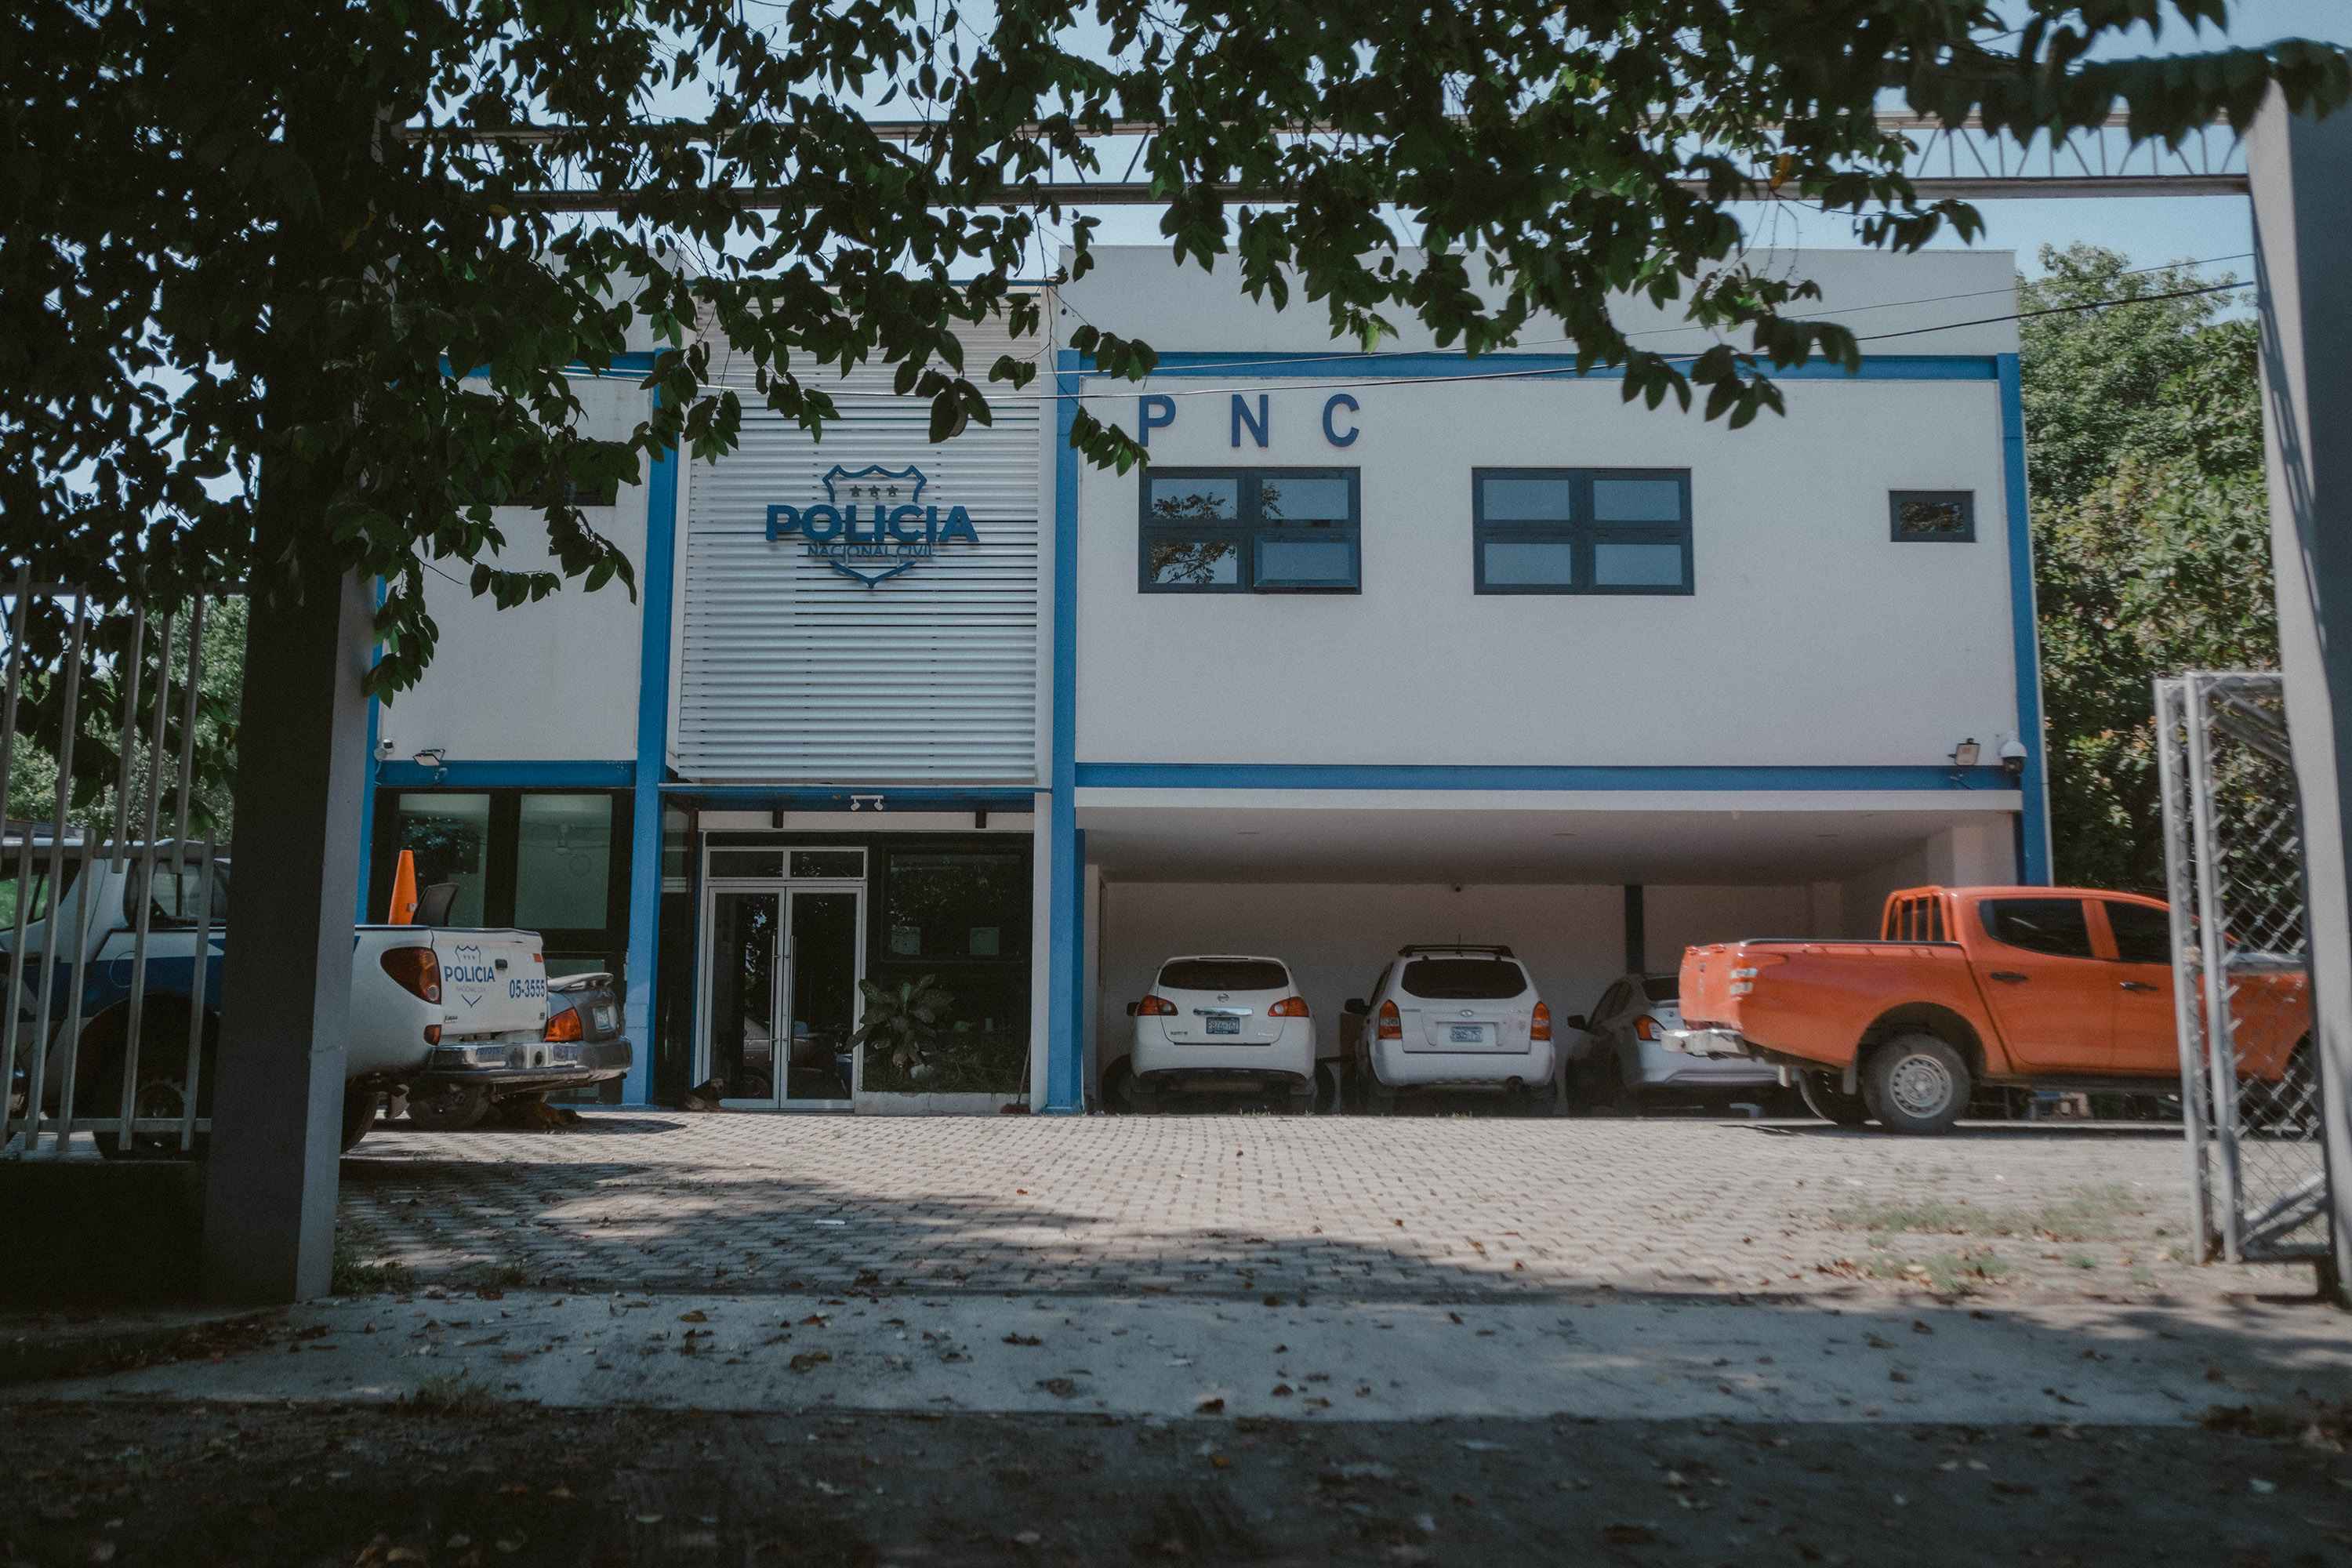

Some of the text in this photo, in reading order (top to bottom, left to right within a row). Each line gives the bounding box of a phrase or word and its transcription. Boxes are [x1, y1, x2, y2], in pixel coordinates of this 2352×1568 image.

[765, 504, 980, 543] POLICIA
[807, 544, 935, 557] NACIONAL CIVIL
[444, 965, 495, 982] POLICIA
[509, 979, 546, 999] 05-3555
